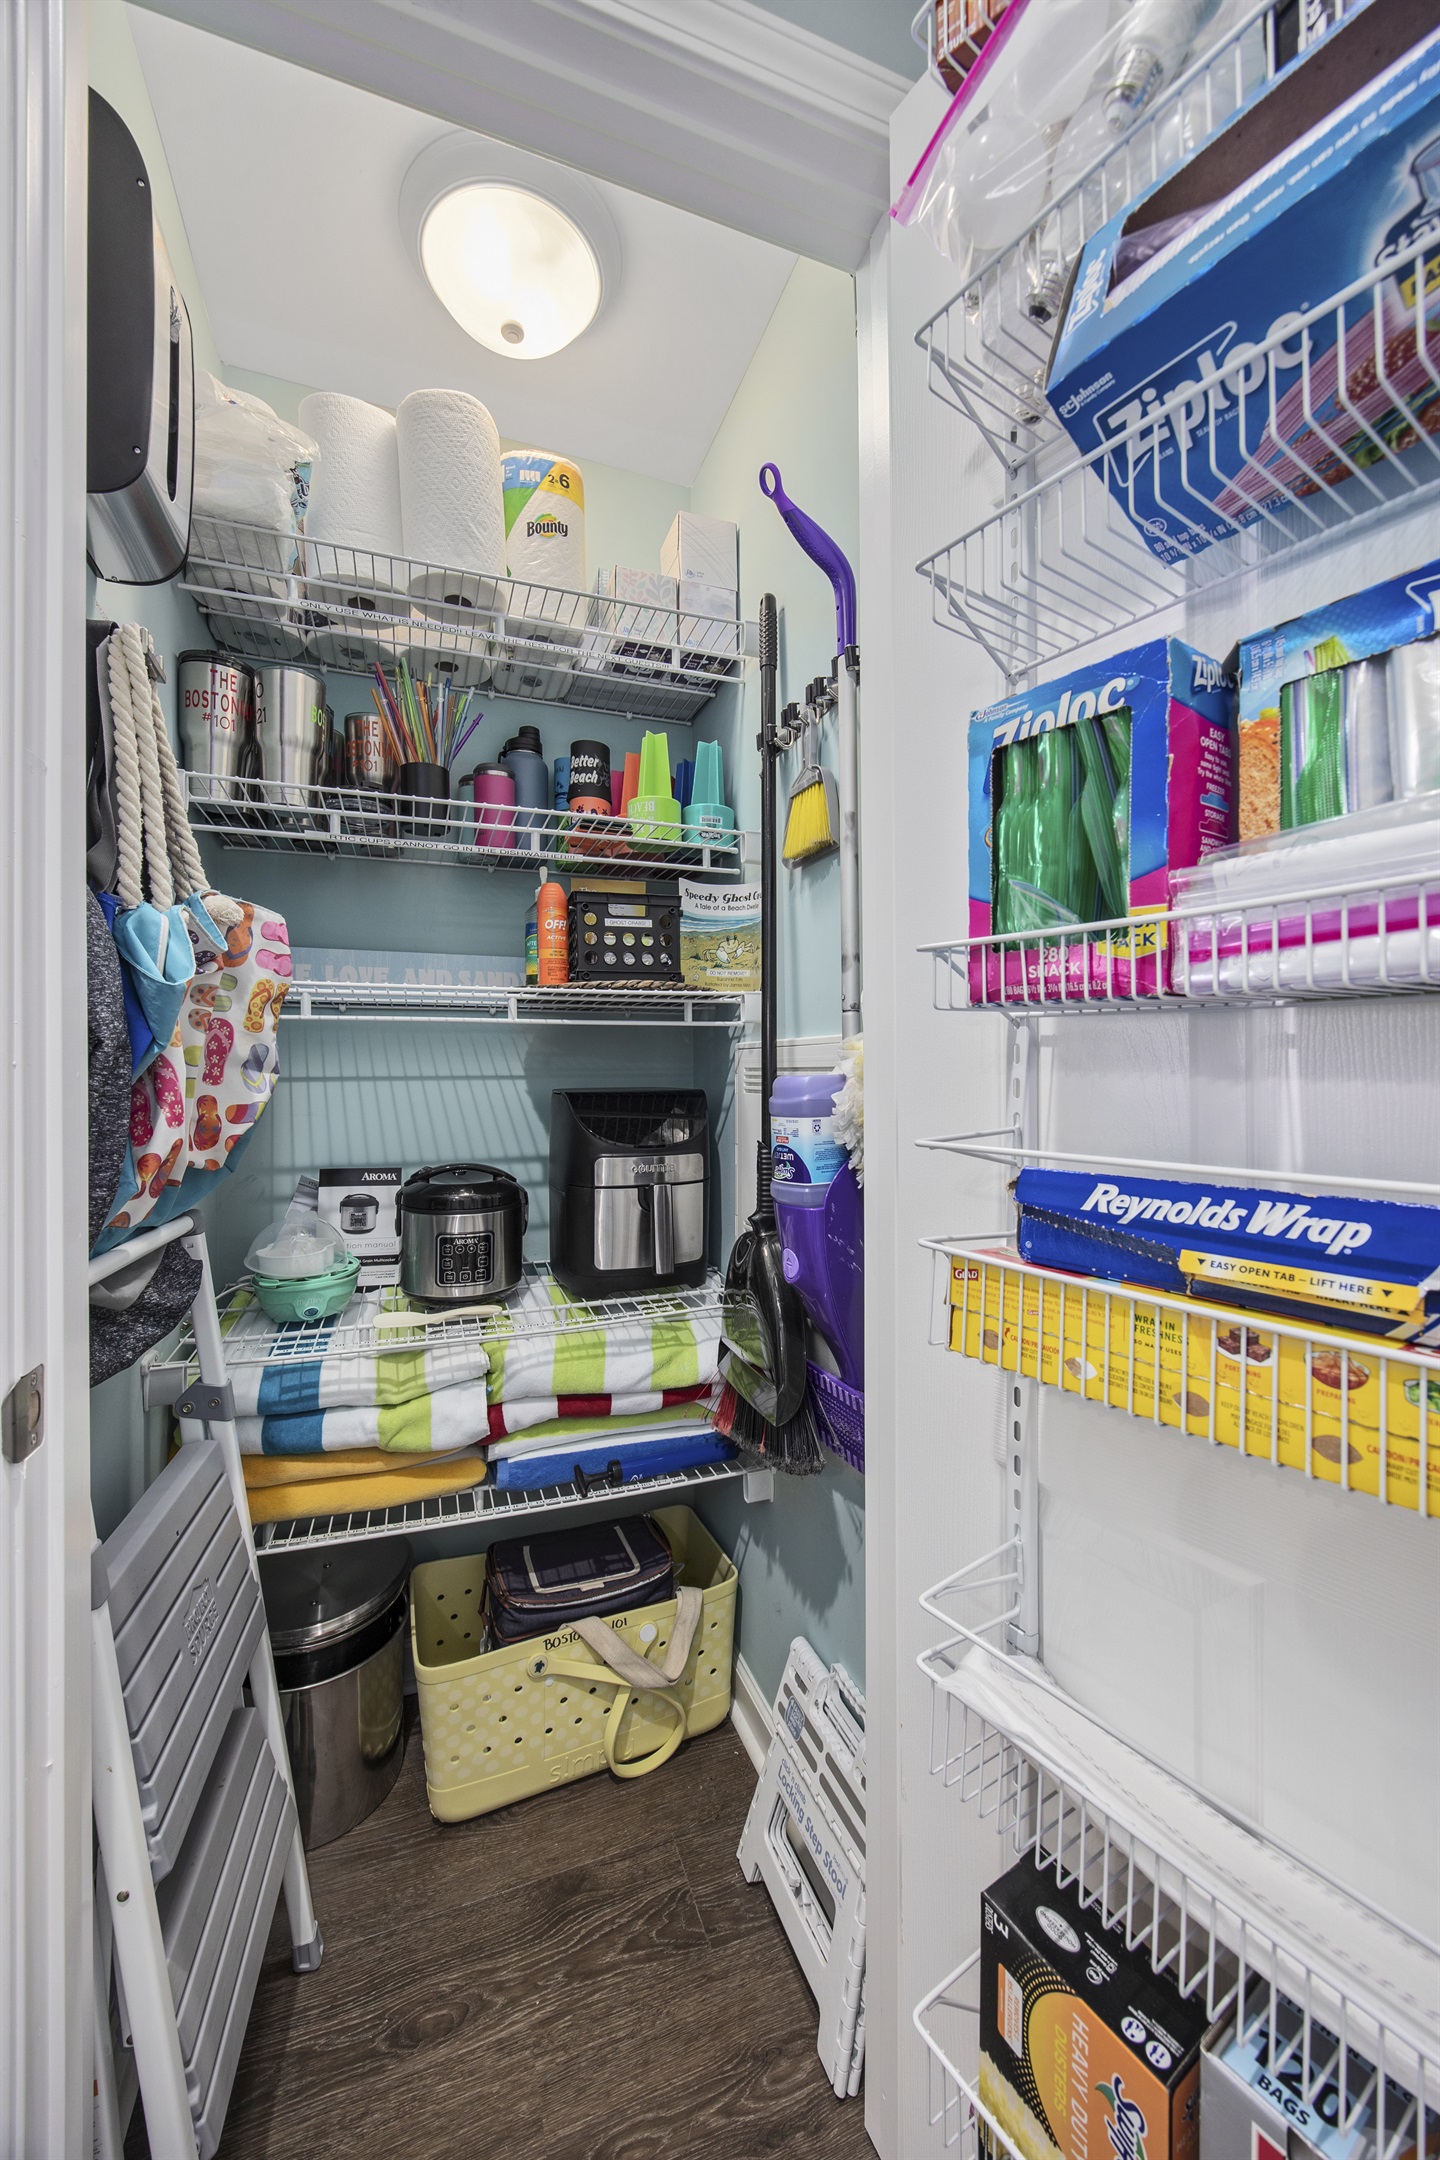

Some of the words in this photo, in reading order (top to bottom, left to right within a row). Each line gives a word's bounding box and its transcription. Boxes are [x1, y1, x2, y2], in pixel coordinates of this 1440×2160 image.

[1107, 311, 1314, 461] Ziploc
[526, 520, 569, 538] Bounty
[299, 599, 333, 612] ONLY
[335, 606, 360, 617] USE
[362, 611, 396, 624] WHAT
[398, 618, 410, 626] IS
[411, 619, 462, 635] NEEDED!!
[464, 629, 498, 641] LEAVE
[502, 636, 523, 646] THE
[524, 638, 550, 651] REST
[553, 644, 575, 655] FOR
[576, 649, 597, 659] THE
[598, 652, 624, 663] NEXT
[210, 668, 238, 694] THE
[201, 711, 236, 732] #101
[356, 719, 379, 738] THE
[1200, 736, 1218, 752] OPEN
[1209, 727, 1226, 743] EASY
[570, 754, 600, 770] Better
[569, 769, 599, 785] Beach
[329, 833, 356, 843] RTIC
[359, 837, 391, 846] CUPS
[393, 840, 440, 850] CANNOT
[476, 847, 497, 855] THE
[684, 887, 720, 904] Speedy
[722, 892, 752, 904] Ghost
[544, 918, 567, 931] OFF!
[361, 1172, 397, 1181] AROMA
[1080, 1182, 1248, 1235] Reynolds
[1244, 1200, 1373, 1256] Wrap
[364, 1240, 397, 1249] manual
[1210, 1259, 1238, 1272] EASY
[1238, 1264, 1270, 1279] OPEN
[1274, 1270, 1296, 1283] TAB
[1309, 1276, 1336, 1290] LIFT
[1339, 1282, 1374, 1297] HERE
[611, 1617, 628, 1629] 101
[777, 1763, 806, 1824] Locking
[804, 1815, 823, 1857] Step
[822, 1850, 848, 1901] Stool
[993, 1911, 1009, 1940] 3
[1039, 1909, 1077, 1949] HOUSEKEEPING
[1071, 2011, 1089, 2104] HEAVY
[1053, 2023, 1068, 2117] DUSTERS
[1255, 2029, 1351, 2129] 120
[1256, 2073, 1312, 2127] BAGS
